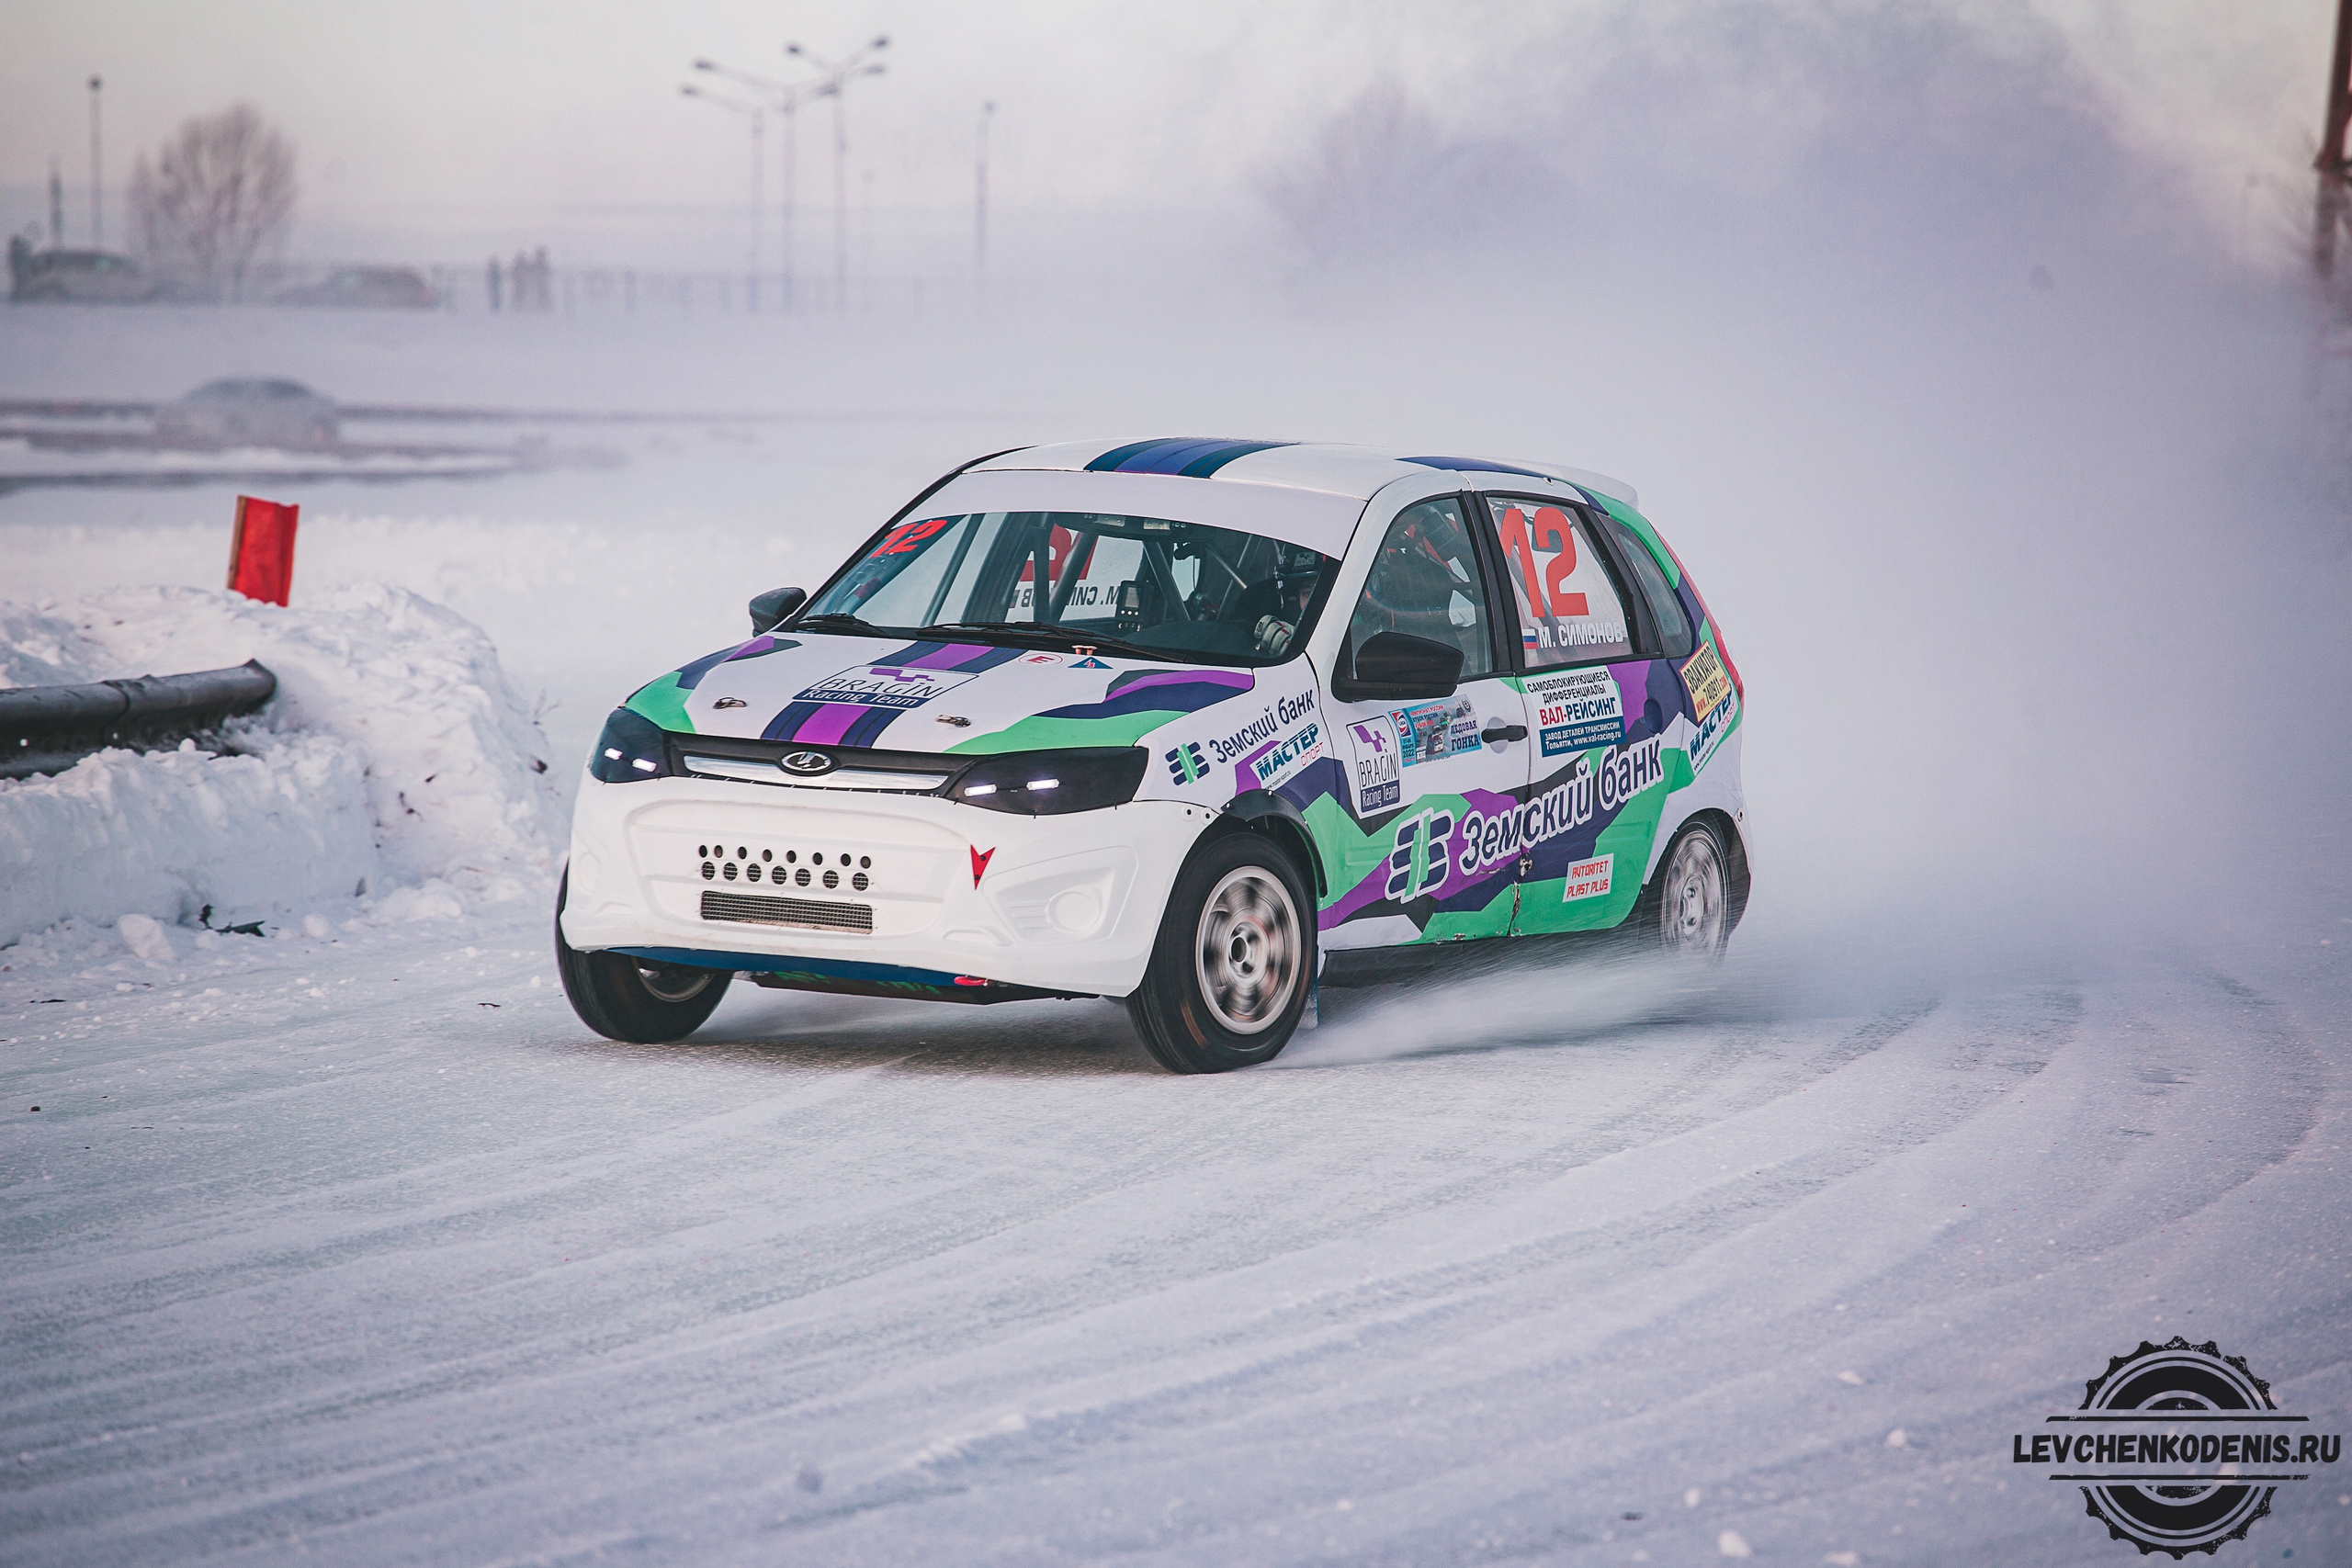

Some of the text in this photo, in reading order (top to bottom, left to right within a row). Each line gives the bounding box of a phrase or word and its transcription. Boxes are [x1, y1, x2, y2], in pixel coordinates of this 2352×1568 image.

[869, 520, 948, 558] 12
[1499, 506, 1589, 618] 12
[1538, 621, 1623, 649] М. СИМОНОВ
[1684, 646, 1718, 694] ЭВАКУАТОР
[1527, 671, 1611, 693] САМОБЛОКИРУЮЩИЕСЯ
[802, 690, 921, 706] Racing Team
[1543, 683, 1607, 705] ДИФФЕРЕНЦИАЛЫ
[1539, 697, 1616, 726] ВАЛ-РЕЙСИНГ
[1209, 689, 1315, 763] Земский банк
[1451, 720, 1477, 734] ЛЕДОВАЯ
[1545, 721, 1620, 740] ЗАВОД ДЕТАЛЕЙ ТРАНСМИССИИ
[1452, 734, 1479, 751] ГОНКА
[1573, 731, 1622, 746] www.val-racing.ru
[1256, 723, 1318, 781] МАСТЕР
[1301, 742, 1324, 766] СПОРТ
[1403, 750, 1414, 758] 2022
[1363, 785, 1397, 807] Racing Team
[1462, 739, 1662, 873] Земский банк
[1566, 878, 1609, 899] PLAST PLUS
